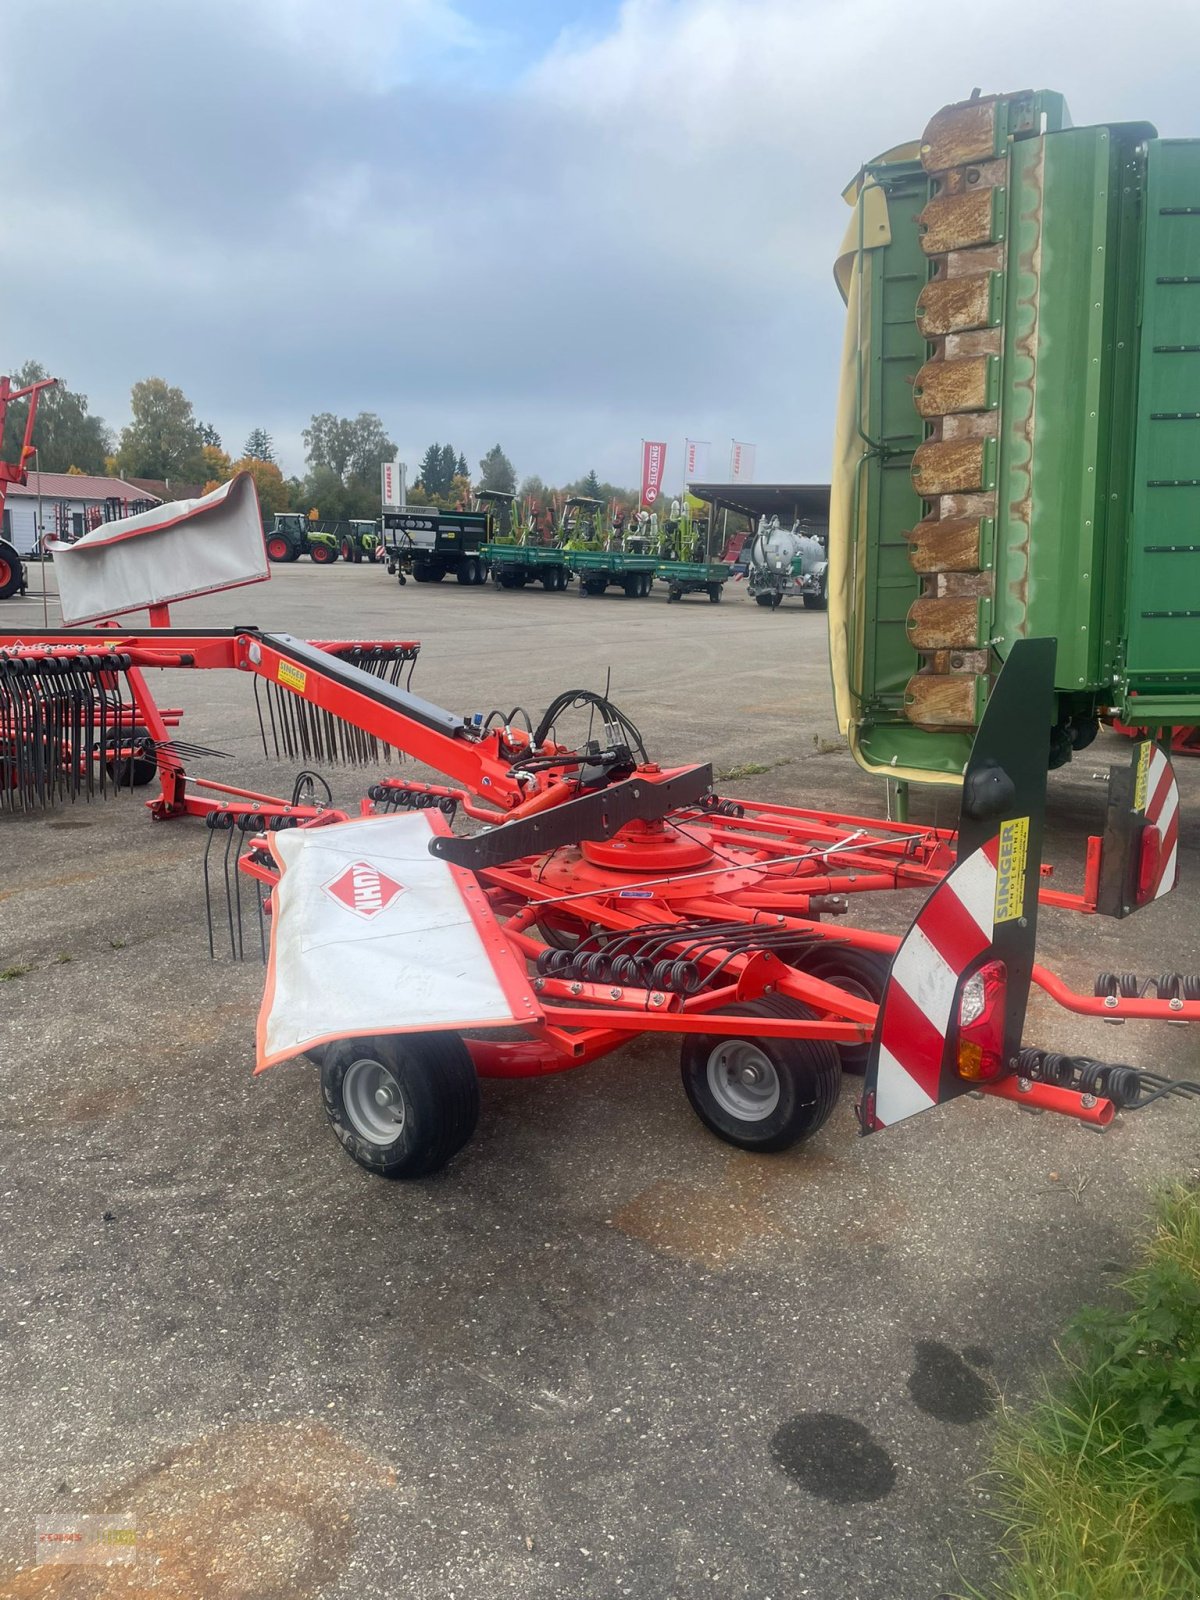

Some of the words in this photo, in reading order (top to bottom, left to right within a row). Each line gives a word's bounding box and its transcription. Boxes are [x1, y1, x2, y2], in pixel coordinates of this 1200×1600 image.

[649, 445, 660, 485] SILOKING
[734, 446, 742, 474] CLAAS
[352, 865, 384, 910] KUHN
[997, 824, 1015, 918] SINGER
[1007, 821, 1019, 917] LANDTECHNIK
